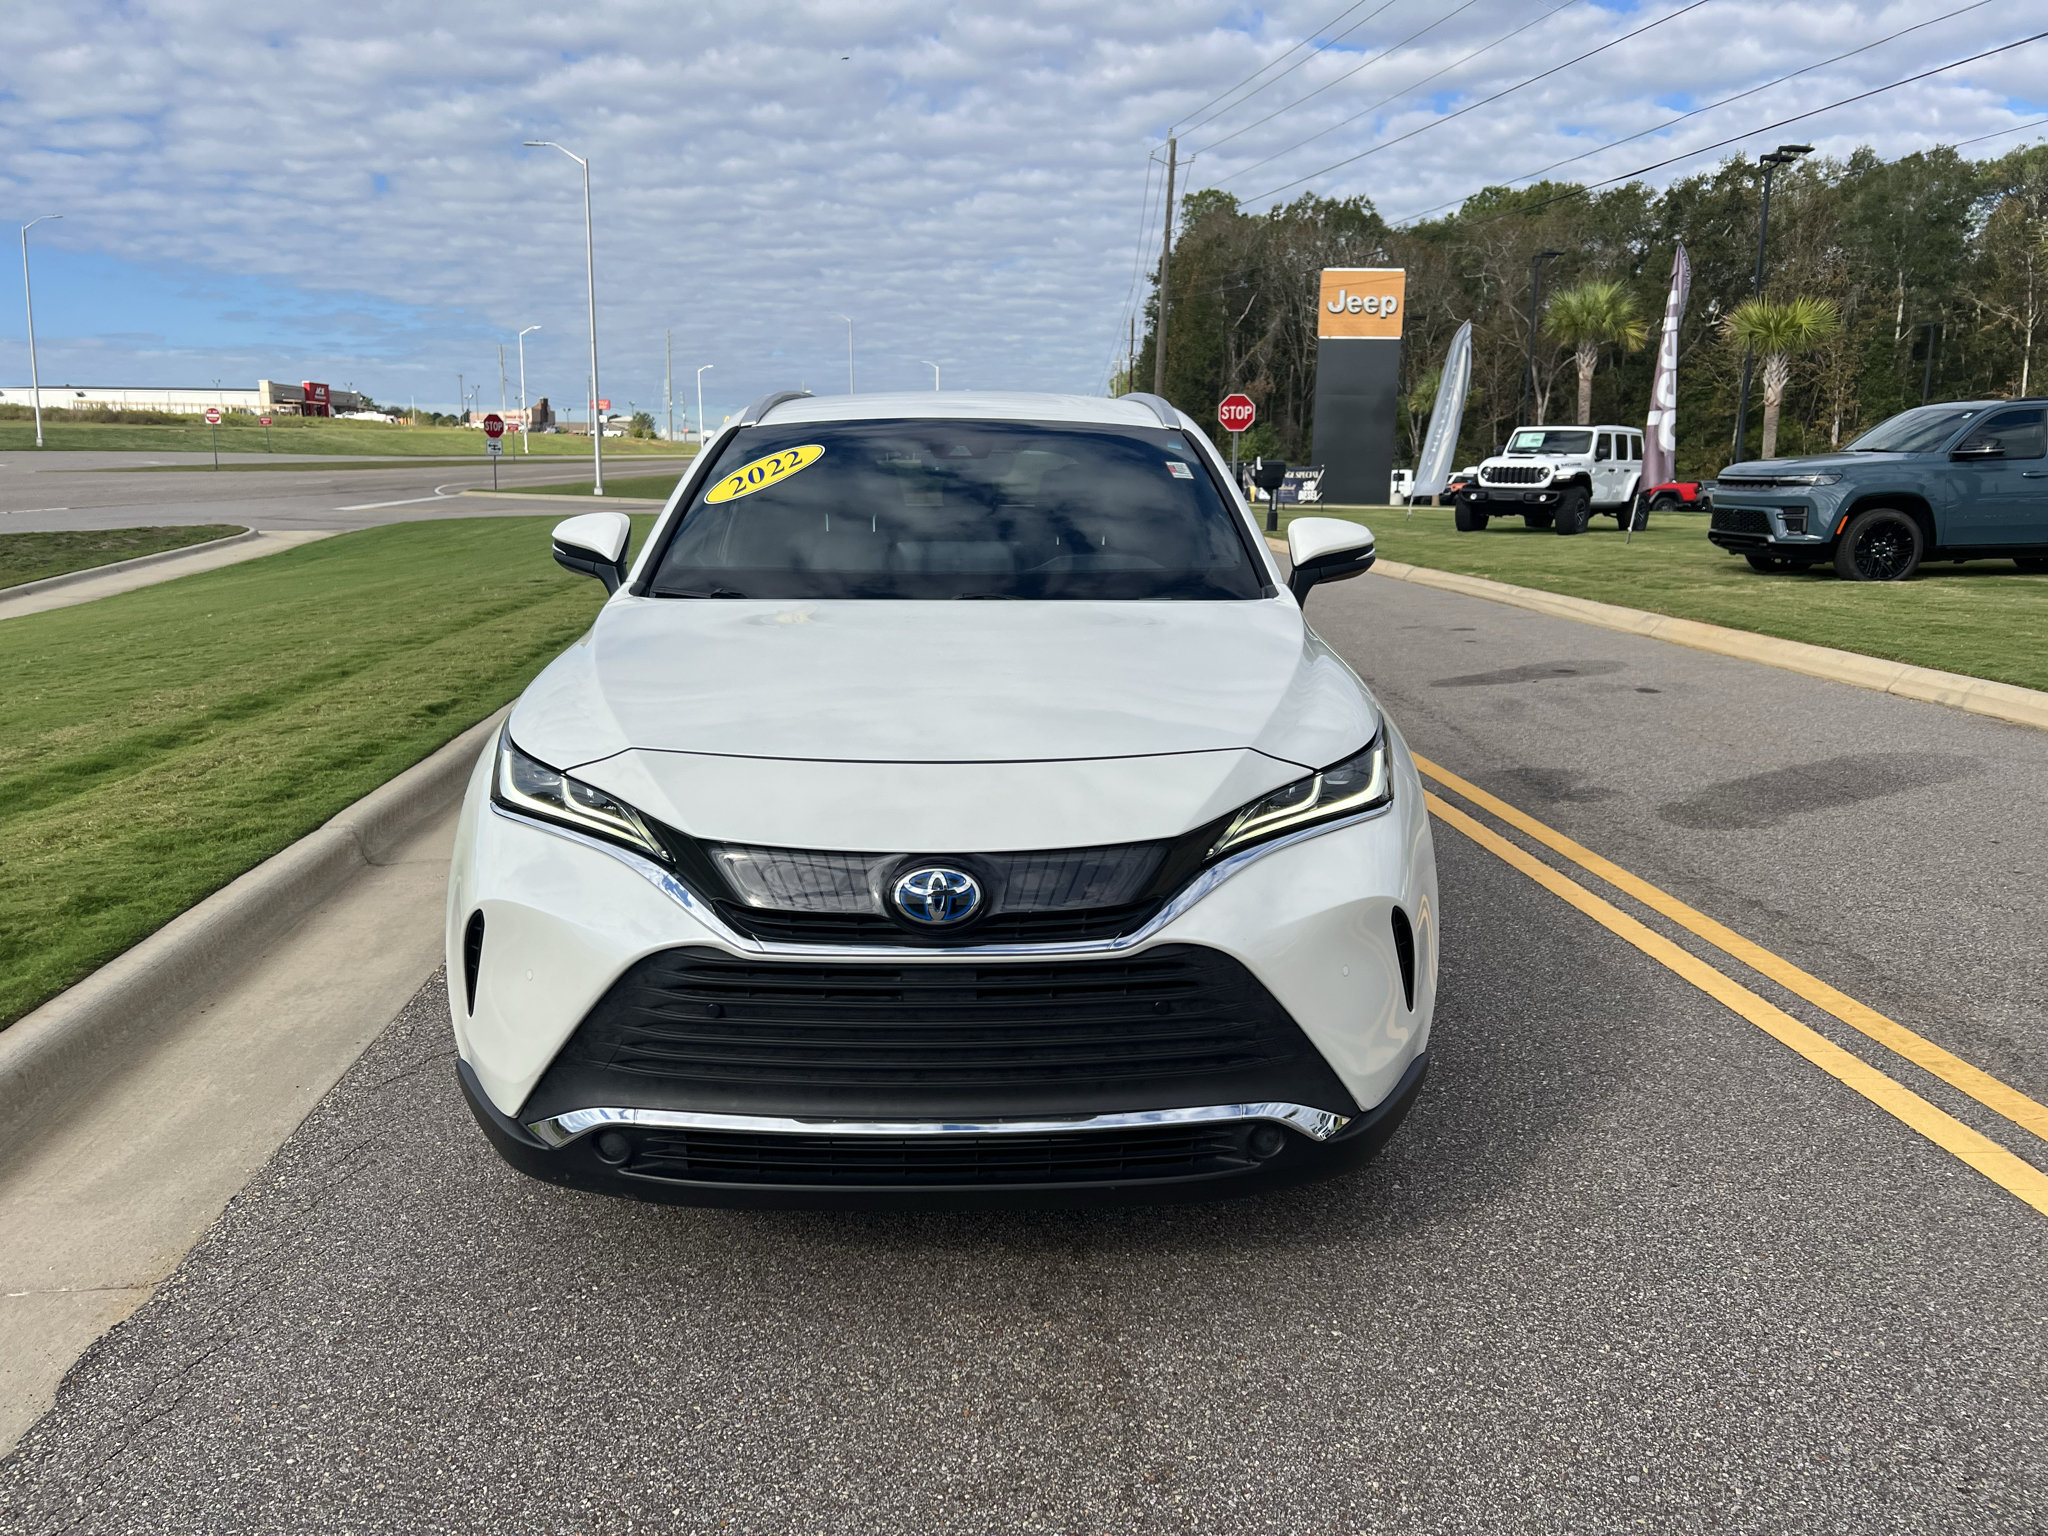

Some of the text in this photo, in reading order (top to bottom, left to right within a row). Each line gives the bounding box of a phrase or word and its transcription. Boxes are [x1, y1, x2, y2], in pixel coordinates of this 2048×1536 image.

[1327, 289, 1398, 318] Jeep
[1221, 406, 1253, 420] STOP
[484, 421, 503, 431] STOP
[728, 451, 803, 496] 2022
